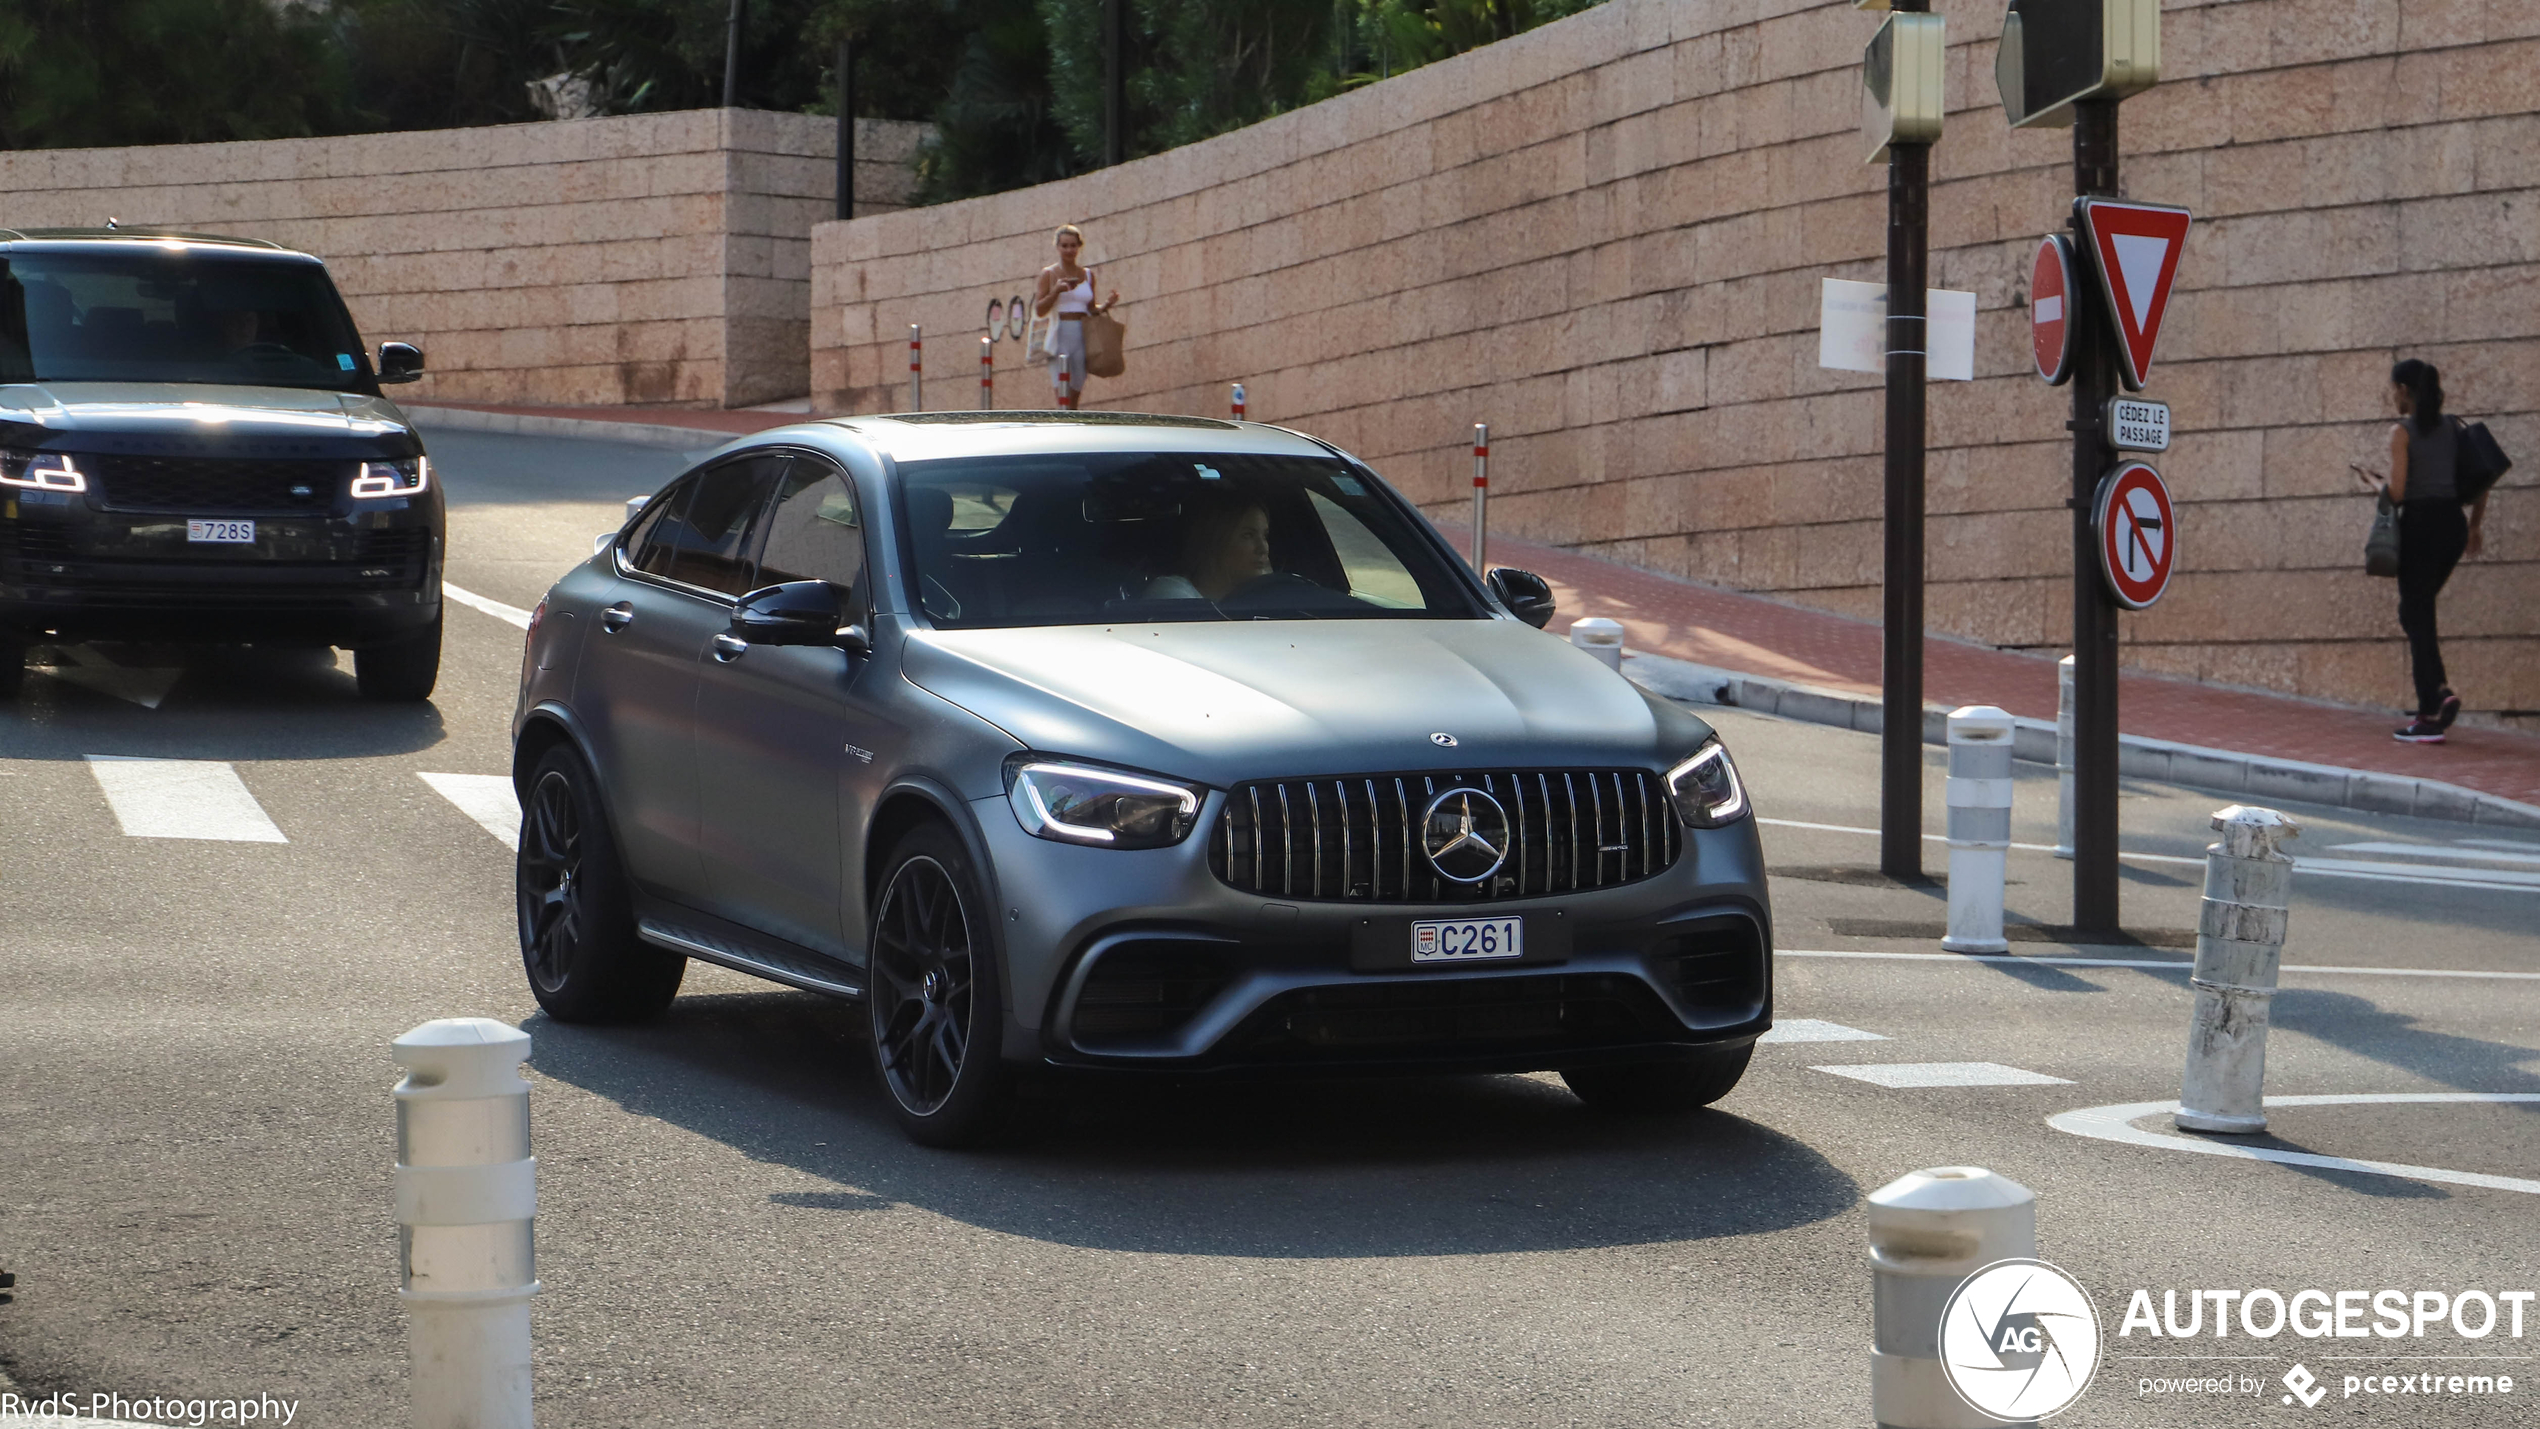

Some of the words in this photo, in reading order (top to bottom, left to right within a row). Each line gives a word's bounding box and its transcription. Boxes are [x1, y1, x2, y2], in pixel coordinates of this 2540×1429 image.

[2119, 402, 2149, 423] CÉDEZ
[2153, 409, 2164, 424] LE
[2120, 425, 2162, 444] PASSAGE
[204, 523, 250, 540] 728S
[1420, 942, 1433, 951] MC
[1441, 922, 1512, 955] C261
